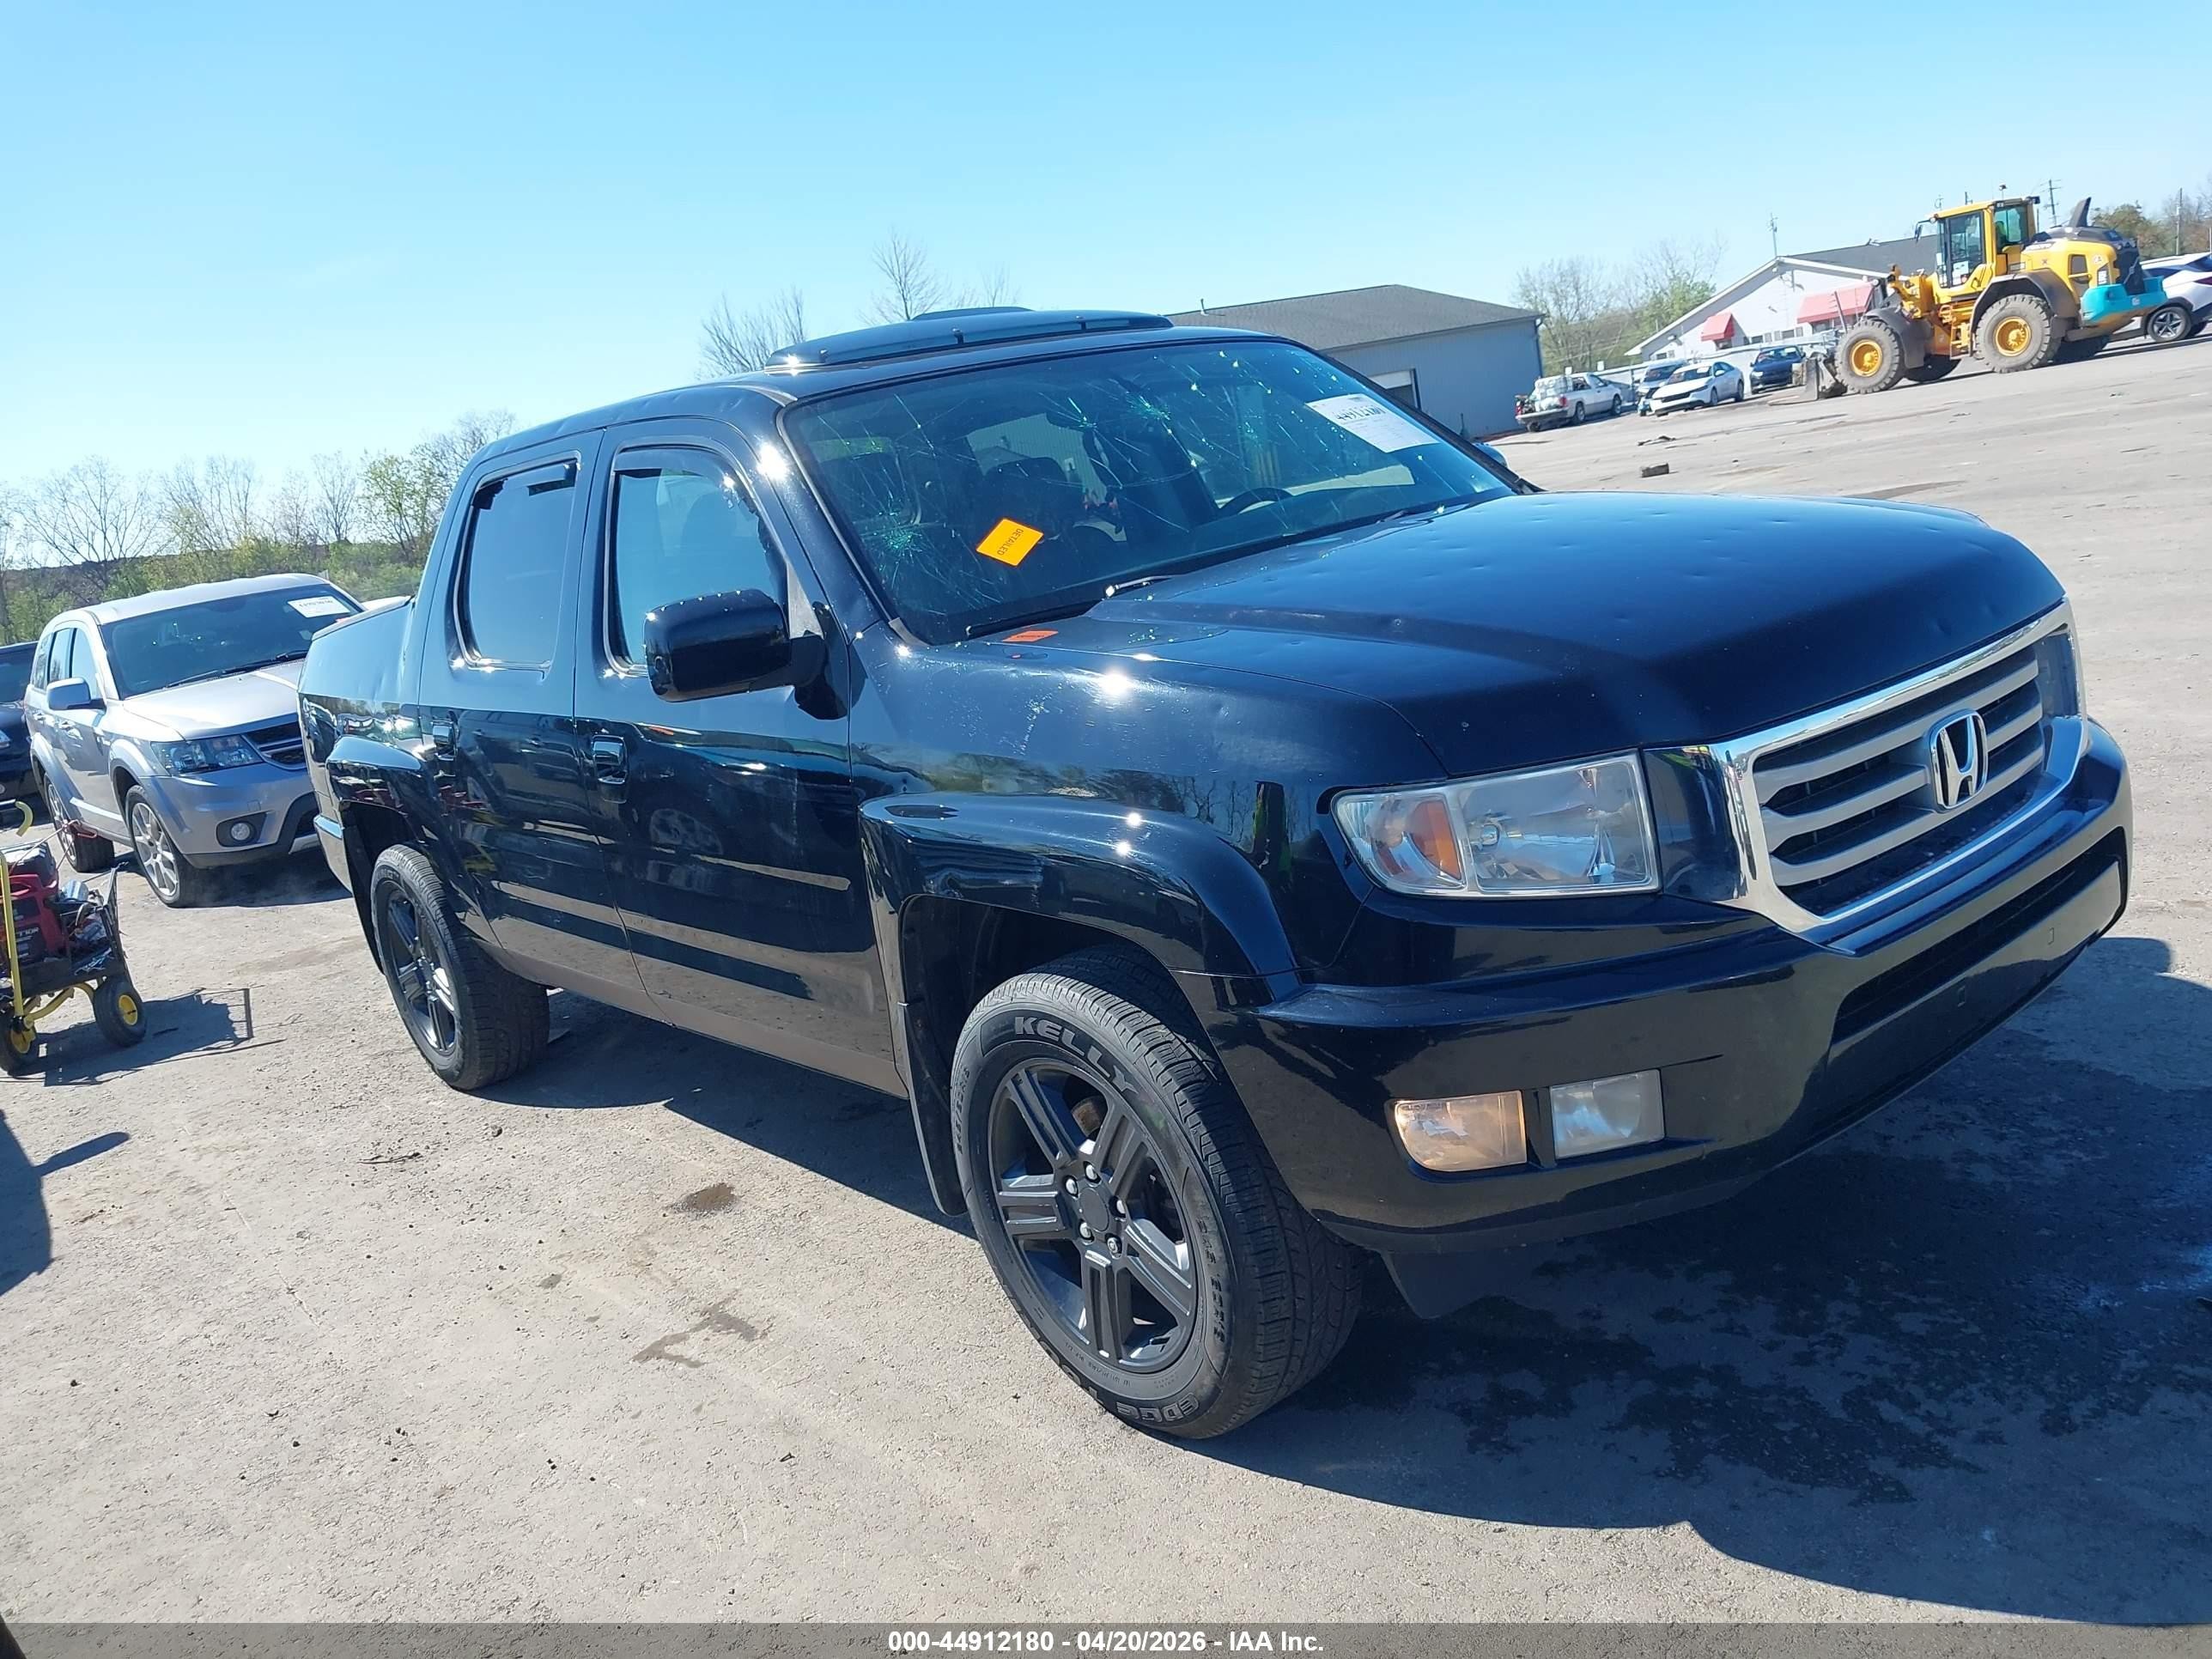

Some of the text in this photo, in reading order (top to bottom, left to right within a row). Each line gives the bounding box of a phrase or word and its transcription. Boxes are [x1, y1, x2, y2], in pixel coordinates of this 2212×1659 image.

[997, 528, 1024, 556] DETAILED
[1014, 1017, 1139, 1095] KELLY
[1116, 1393, 1200, 1423] EDGE
